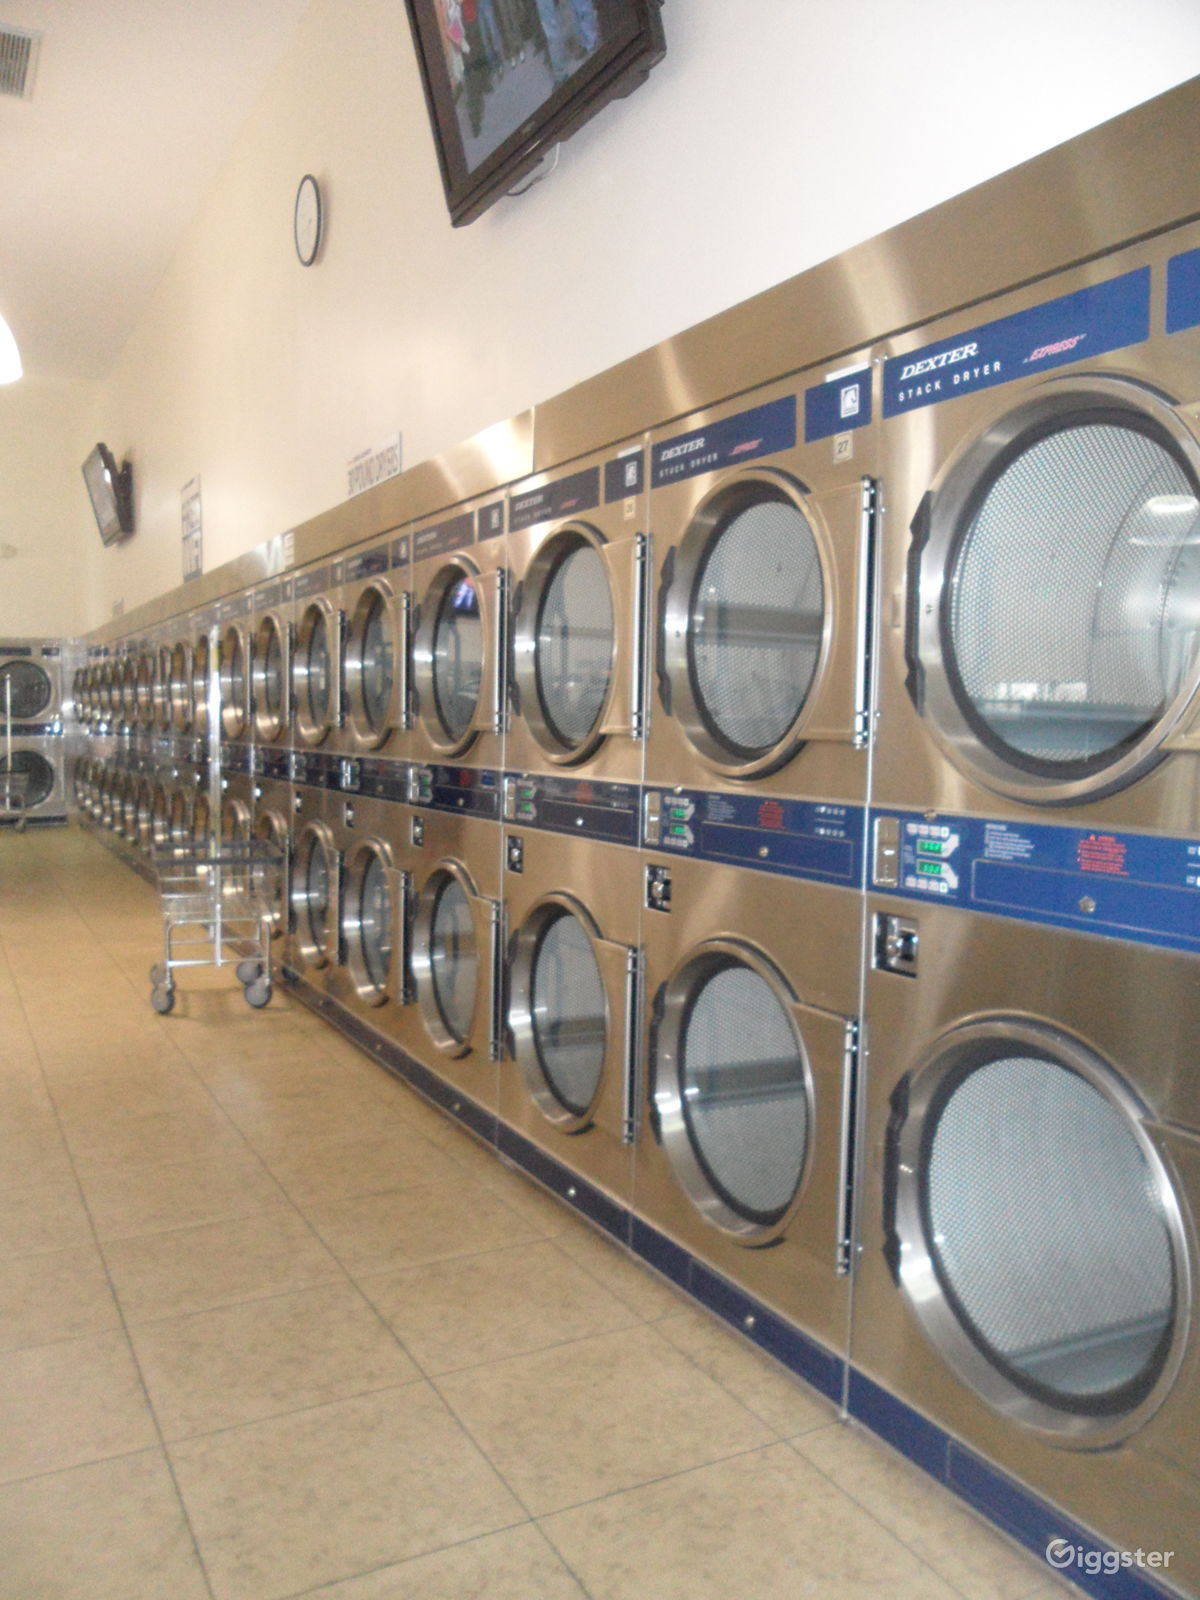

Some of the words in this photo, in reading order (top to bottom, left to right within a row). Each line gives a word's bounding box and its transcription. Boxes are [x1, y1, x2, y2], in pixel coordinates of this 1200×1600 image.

[900, 342, 979, 380] DEXTER
[899, 380, 941, 402] STACK
[953, 361, 1001, 385] DRYER
[660, 437, 705, 462] DEXTER
[838, 440, 849, 454] 27
